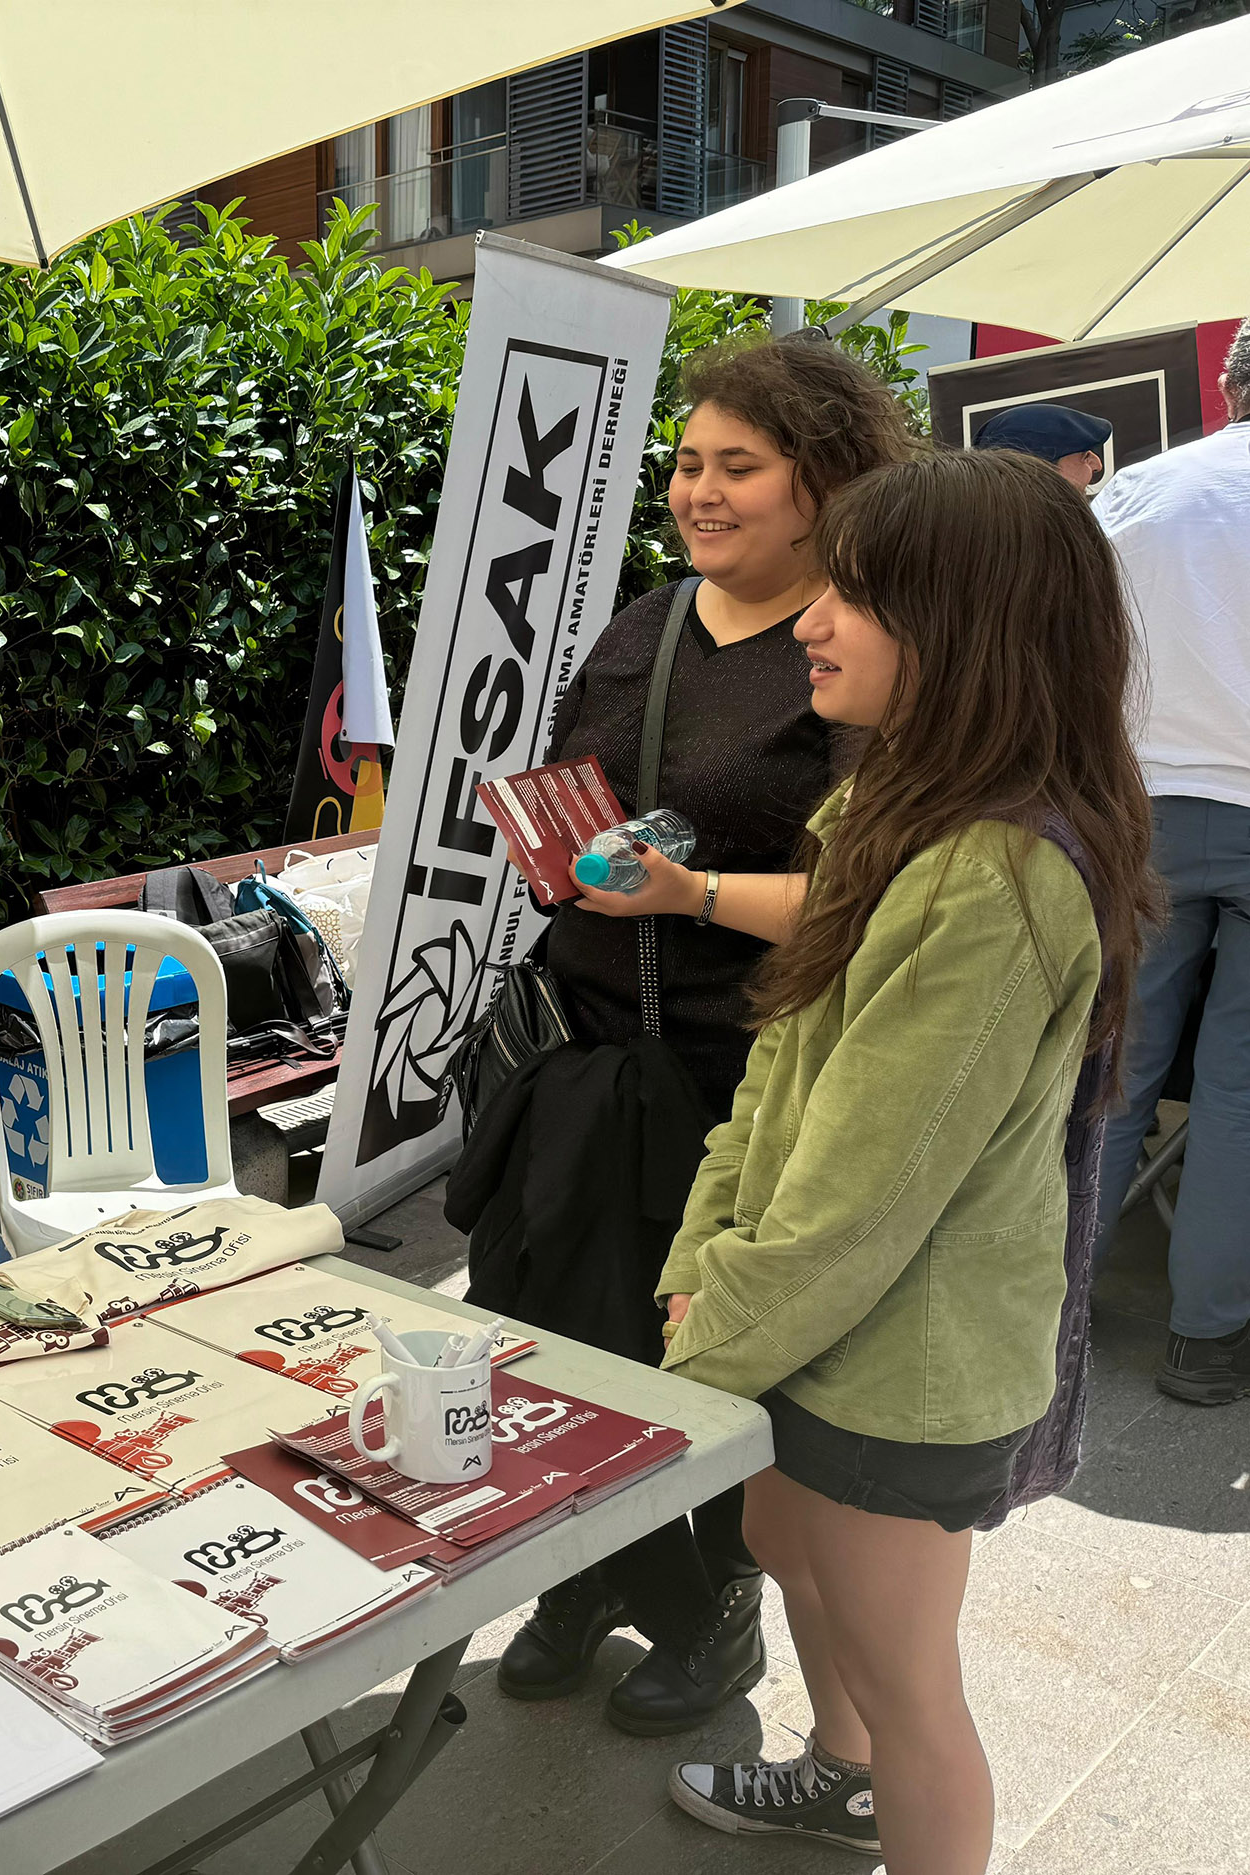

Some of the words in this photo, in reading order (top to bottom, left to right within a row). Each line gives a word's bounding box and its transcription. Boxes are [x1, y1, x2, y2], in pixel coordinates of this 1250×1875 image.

[568, 478, 607, 636] AMATÖRLERİ
[598, 357, 629, 469] DERNEĞİ
[222, 1232, 252, 1256] Ofisi
[117, 1404, 158, 1424] Mersin
[156, 1391, 200, 1409] Sinema
[445, 1436, 468, 1446] Mersin
[536, 1420, 579, 1442] Sinema
[335, 1504, 384, 1524] Mersin
[220, 1564, 253, 1584] Mersin
[250, 1550, 286, 1570] Sinema
[281, 1538, 306, 1553] Ofisi
[34, 1621, 73, 1642] Mersin
[68, 1604, 107, 1624] Sinema
[103, 1592, 129, 1606] Ofisi
